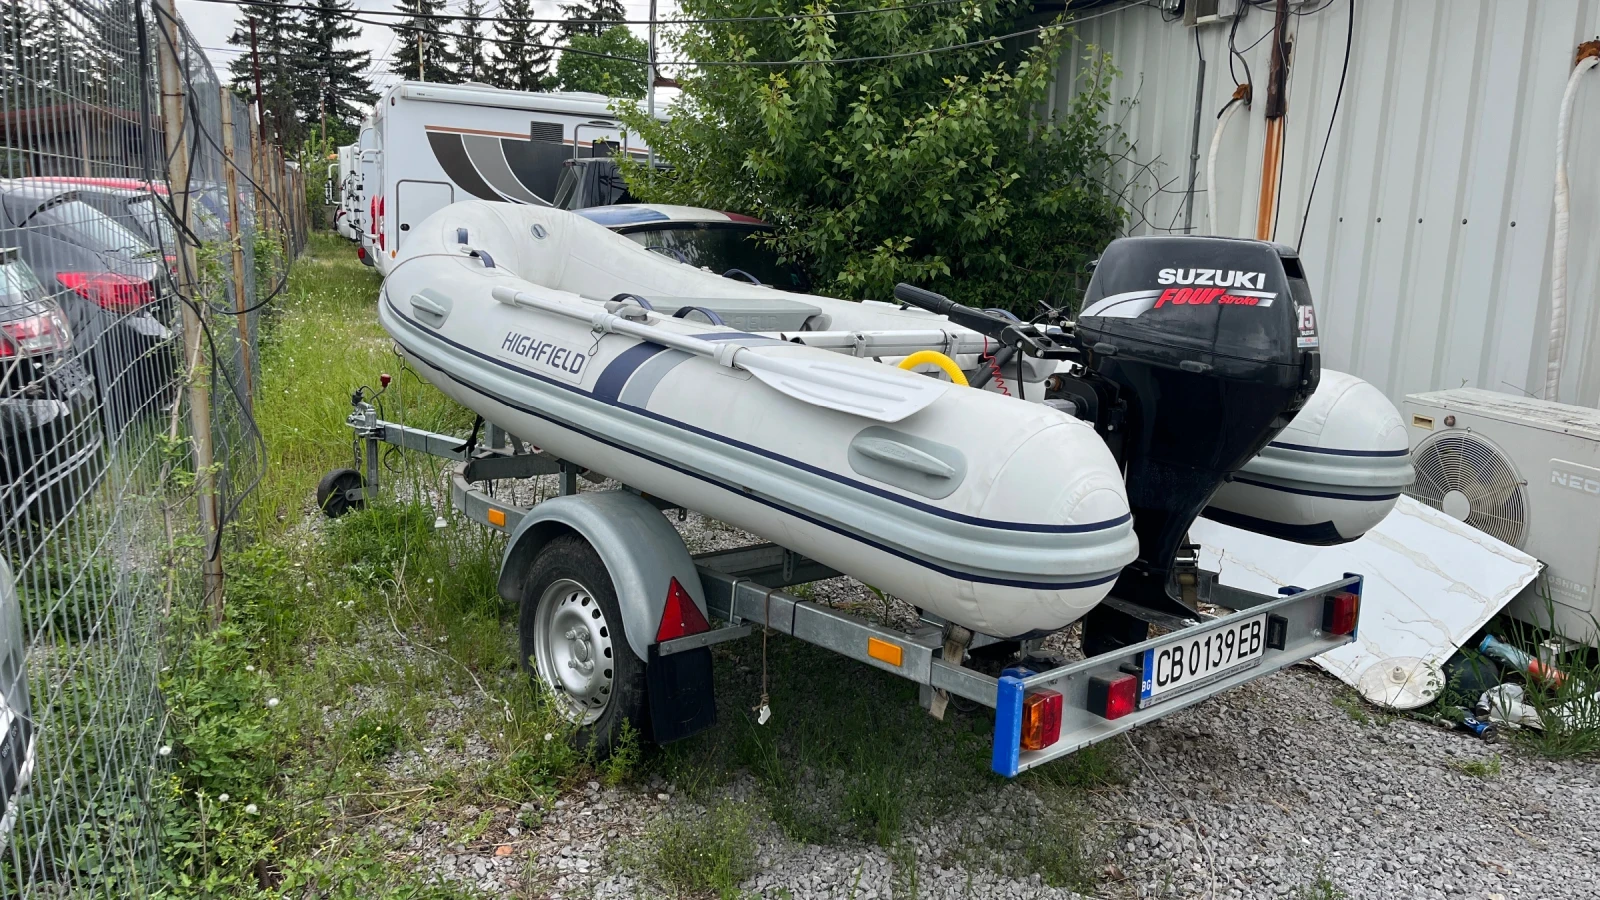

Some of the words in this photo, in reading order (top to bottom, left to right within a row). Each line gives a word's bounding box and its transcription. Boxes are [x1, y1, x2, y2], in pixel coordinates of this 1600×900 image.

[1157, 268, 1266, 290] SUZUKI
[1218, 294, 1259, 306] Stroke
[1298, 305, 1314, 330] 15
[501, 331, 586, 375] HIGHFIELD
[1141, 680, 1151, 692] BG
